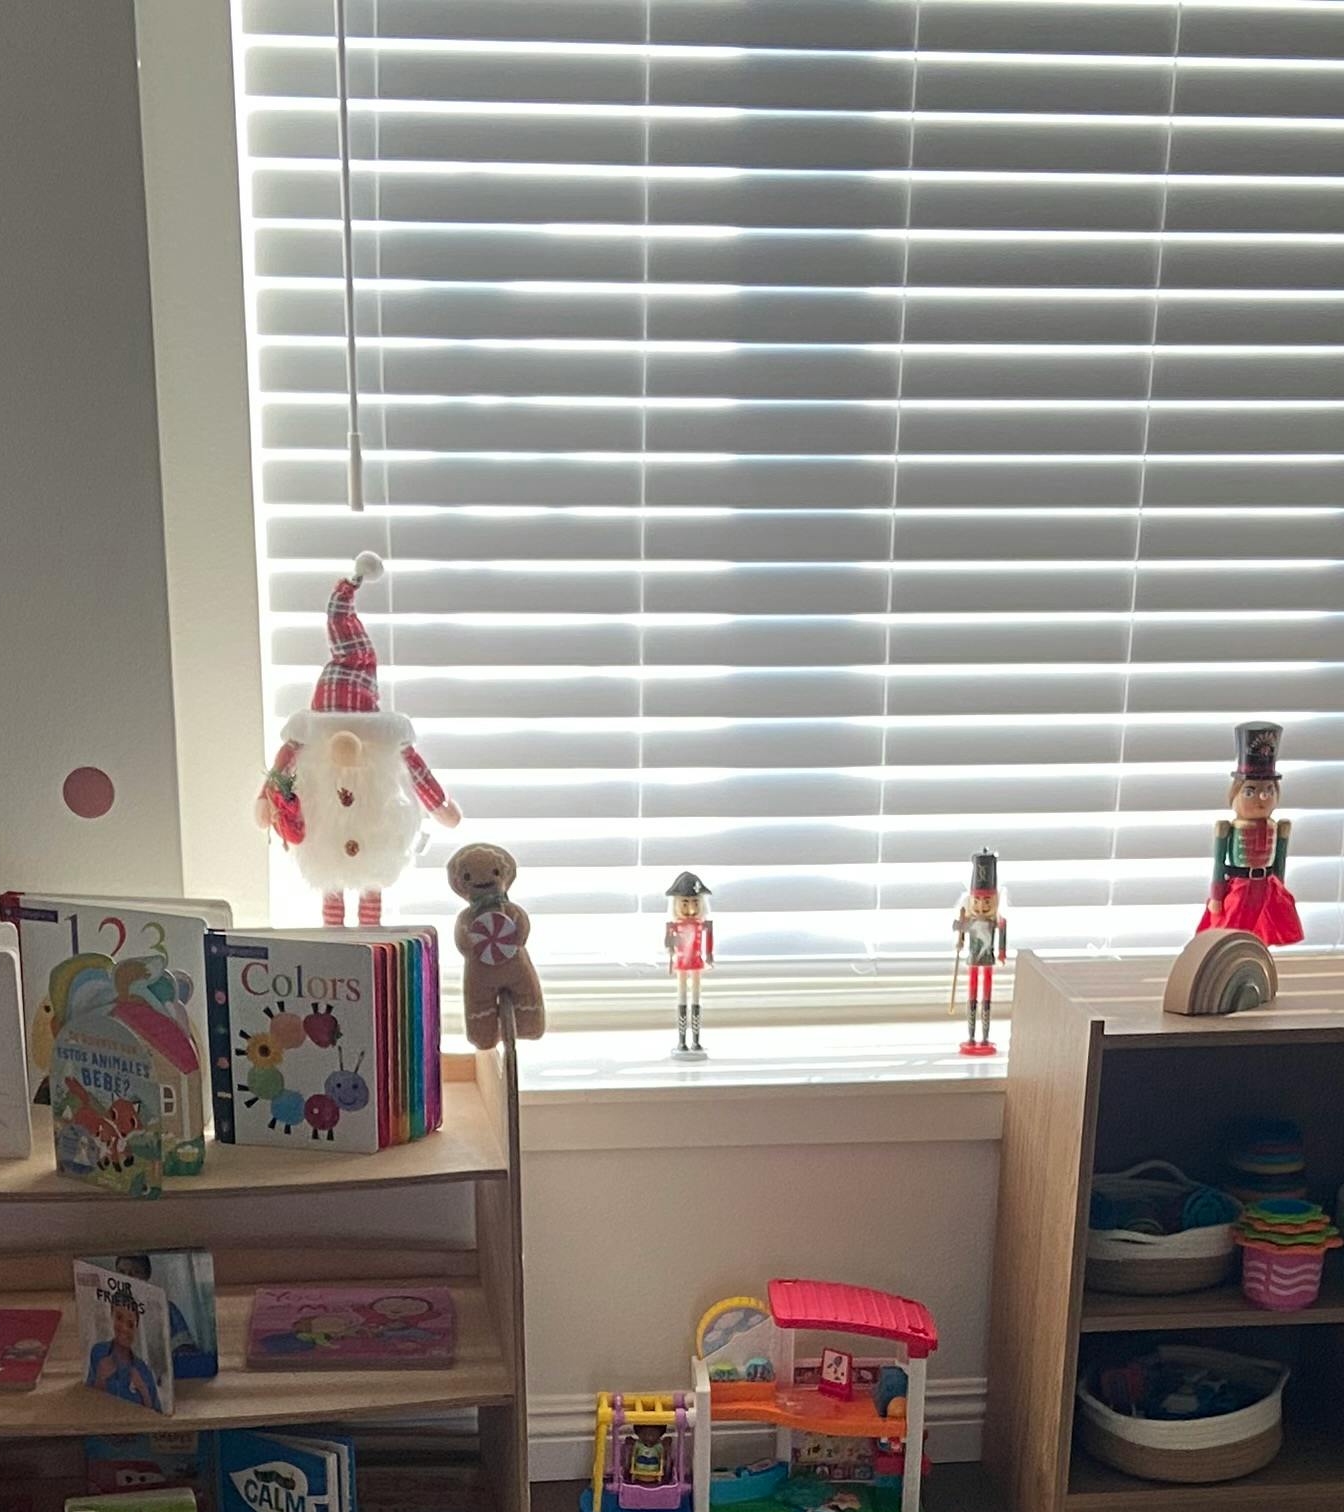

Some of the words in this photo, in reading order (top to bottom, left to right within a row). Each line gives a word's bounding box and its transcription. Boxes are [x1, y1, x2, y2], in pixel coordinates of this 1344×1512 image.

[241, 961, 362, 1002] Colors
[57, 1046, 87, 1063] ESTOS
[91, 1052, 149, 1079] ANIMALES
[107, 1277, 132, 1296] OUR
